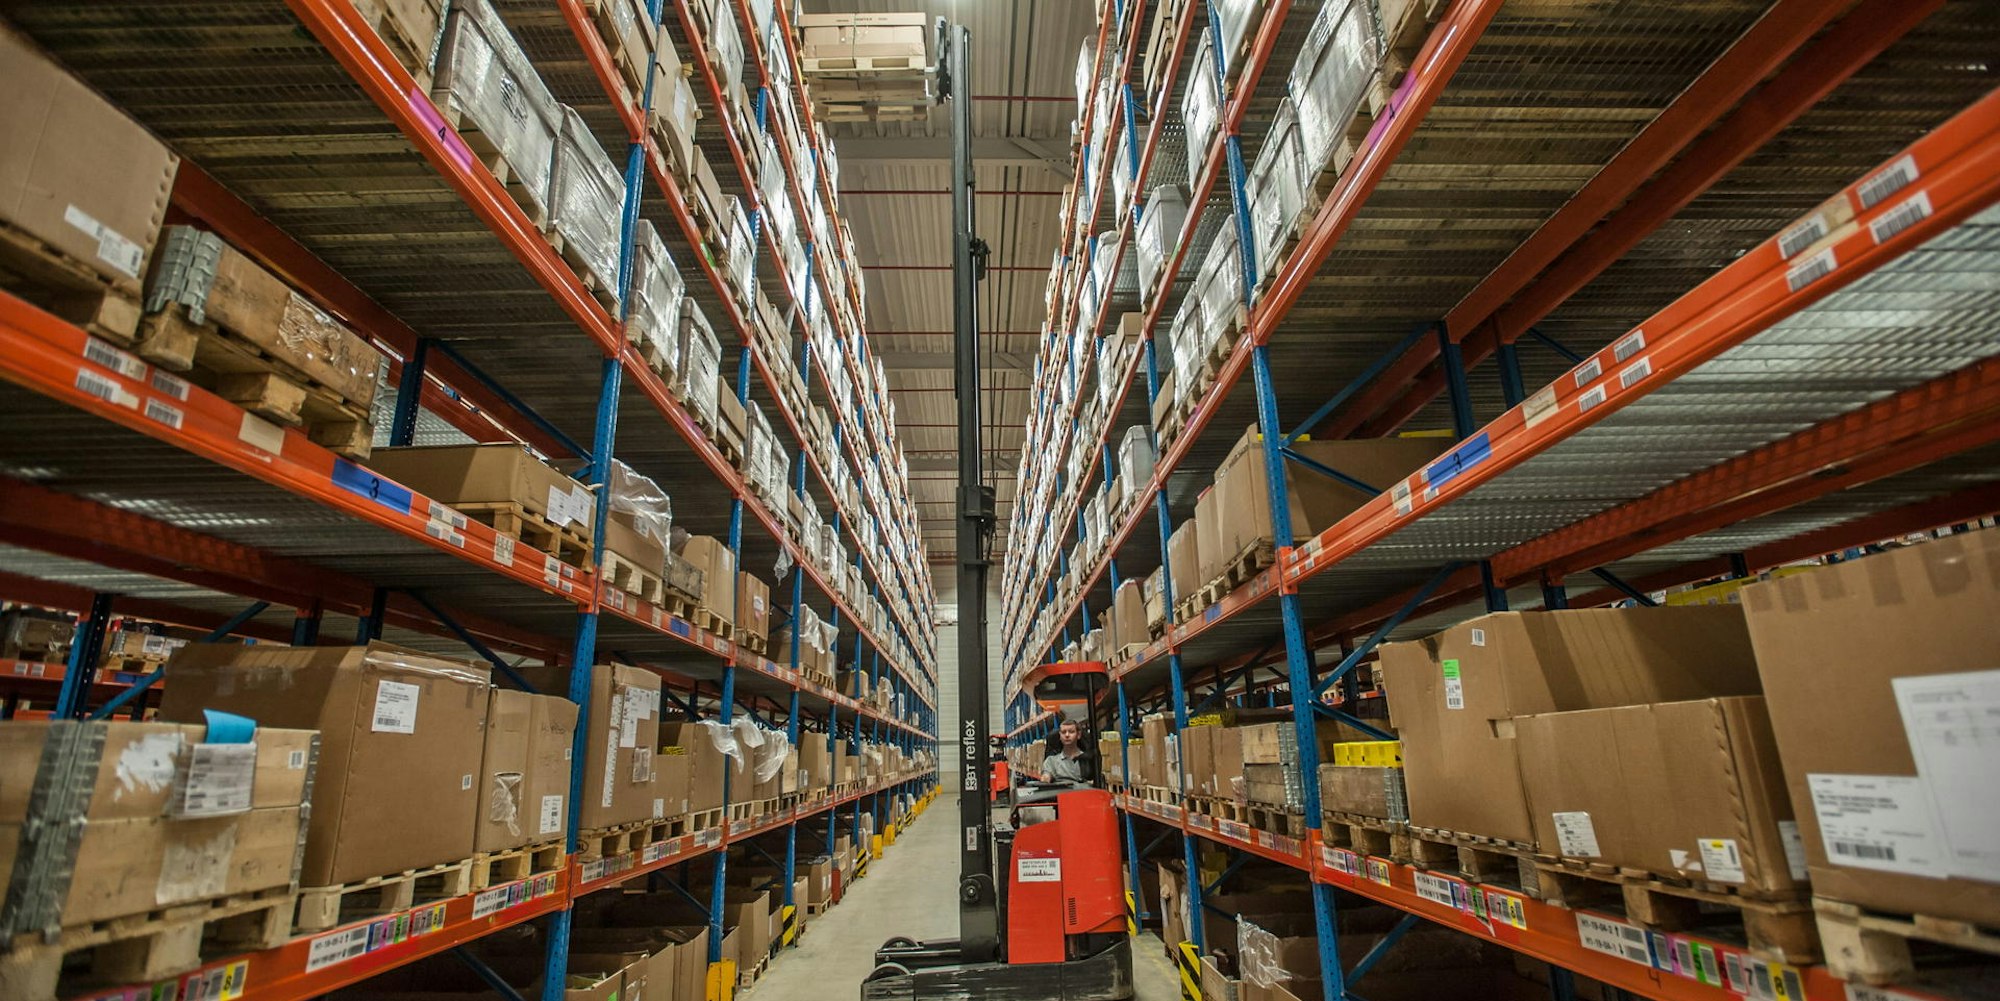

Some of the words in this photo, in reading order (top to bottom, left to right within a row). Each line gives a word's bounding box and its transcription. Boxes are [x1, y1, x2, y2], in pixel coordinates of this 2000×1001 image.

[438, 126, 447, 142] 4
[369, 477, 380, 499] 3
[963, 719, 976, 760] reflex
[966, 763, 976, 780] BT
[223, 975, 232, 991] 8
[1744, 967, 1753, 985] 7
[1774, 976, 1785, 997] 8
